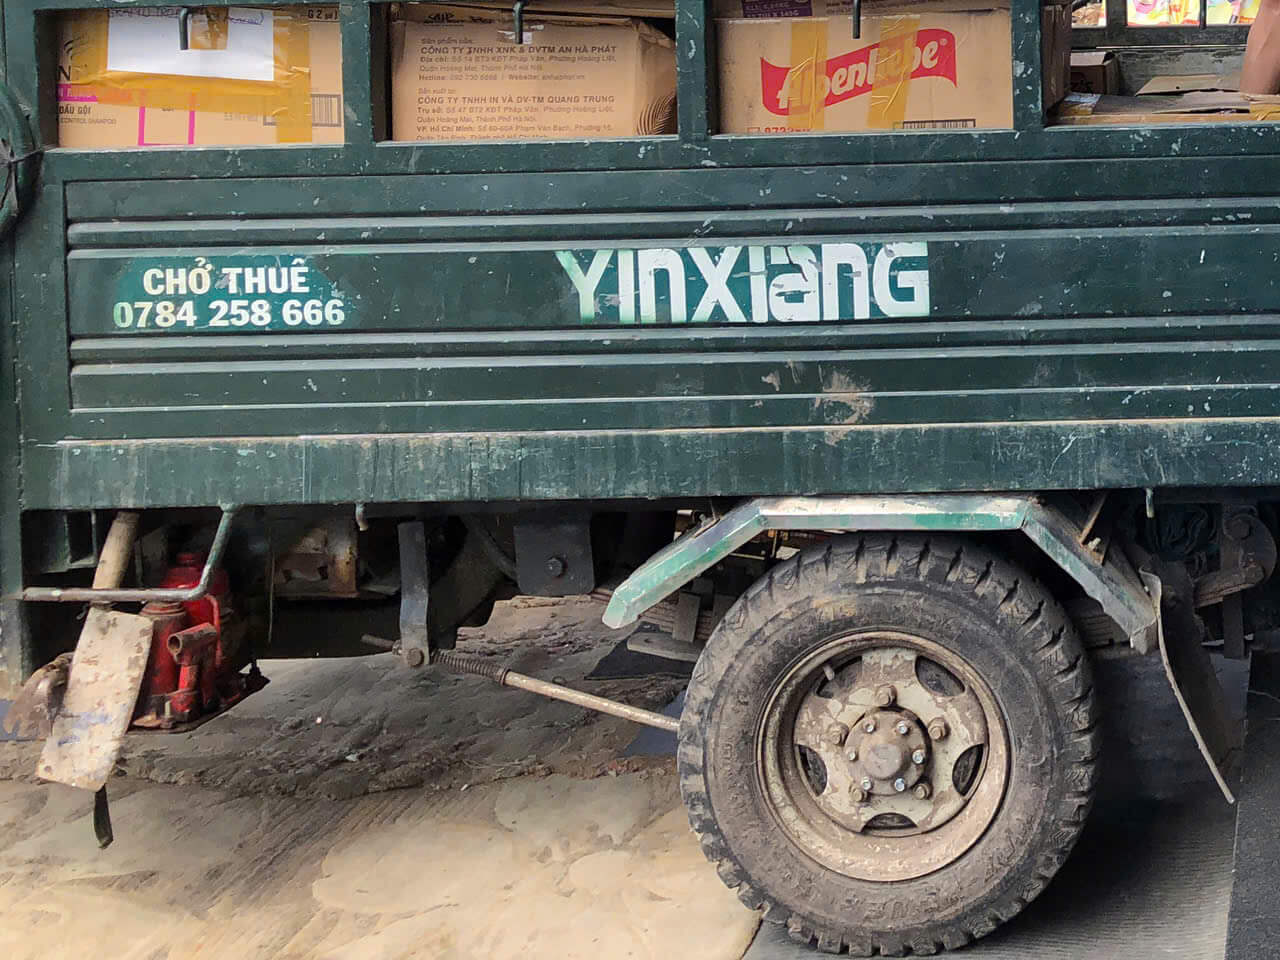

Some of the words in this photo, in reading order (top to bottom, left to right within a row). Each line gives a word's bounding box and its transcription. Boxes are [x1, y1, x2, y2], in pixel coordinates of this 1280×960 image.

[452, 44, 463, 54] TY
[558, 44, 572, 53] AN
[583, 95, 615, 103] TRUNG
[143, 257, 213, 295] CHỞ
[221, 258, 310, 294] THUÊ
[113, 300, 197, 328] 0784
[208, 299, 271, 327] 258
[281, 299, 345, 326] 666
